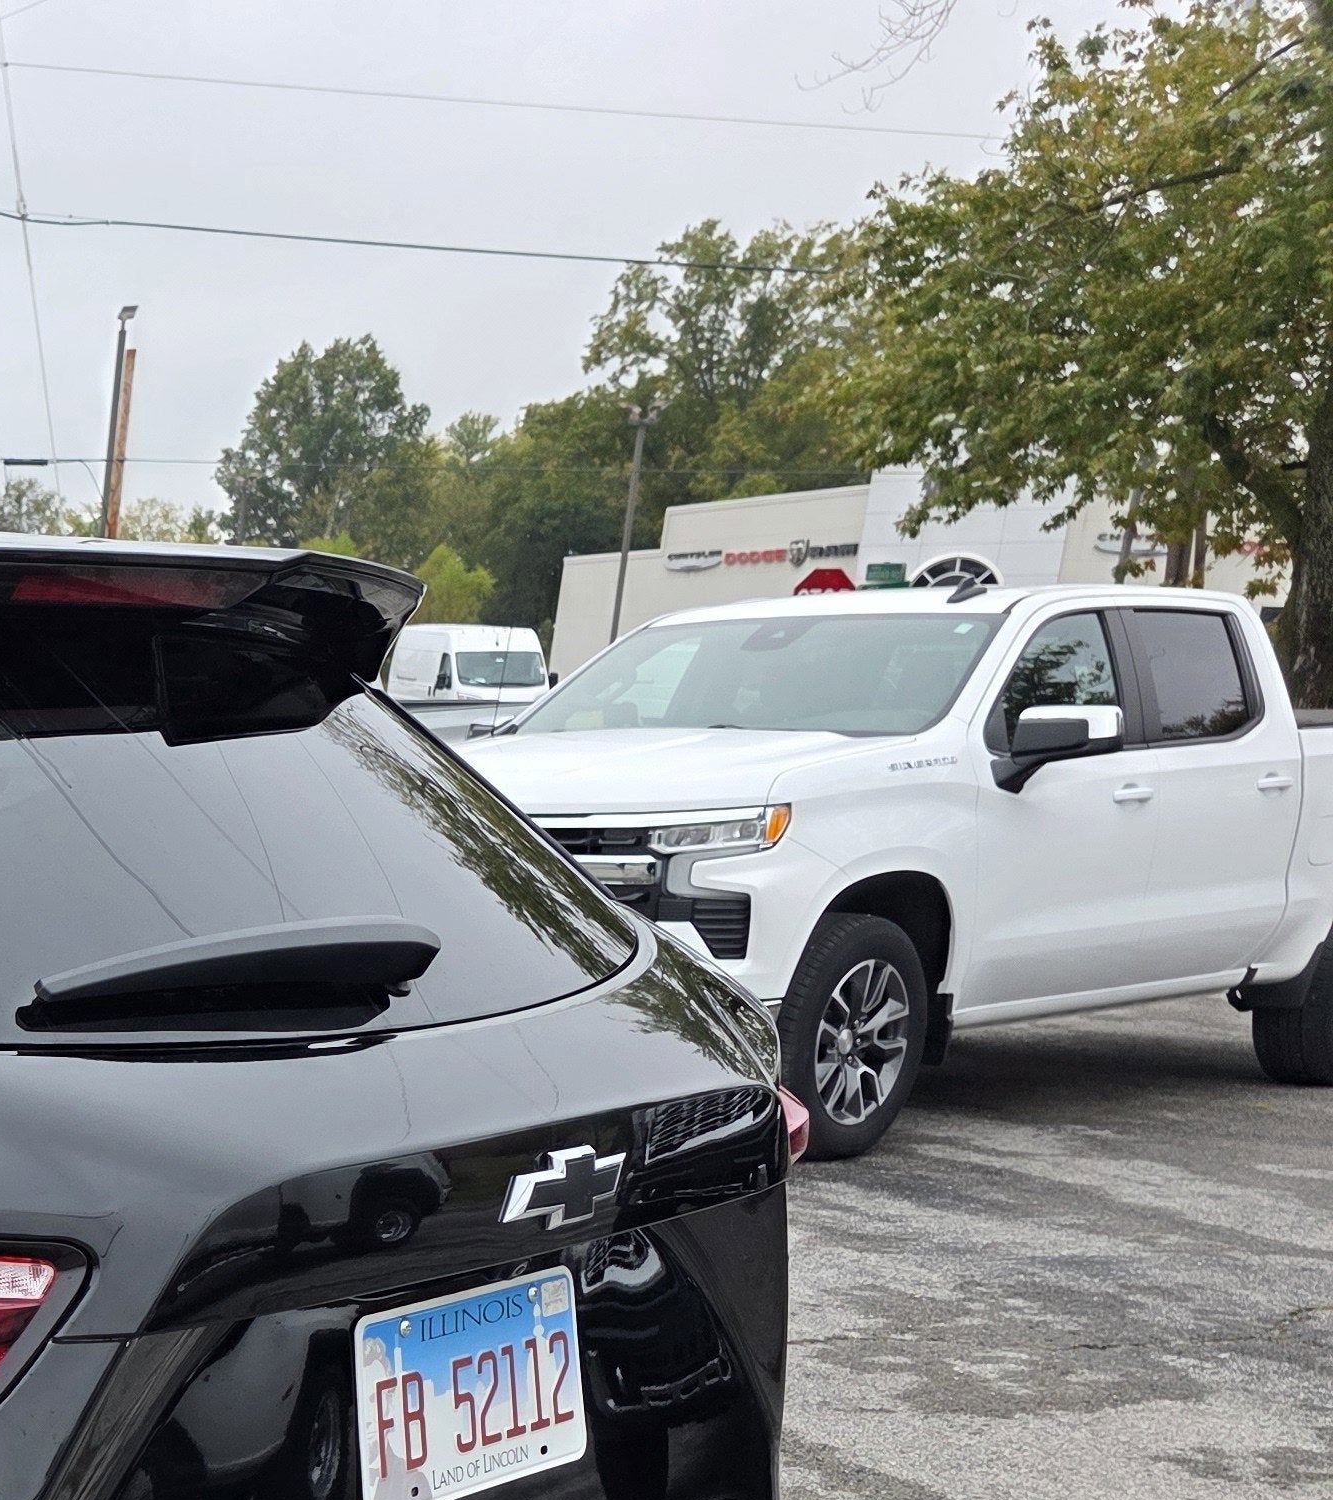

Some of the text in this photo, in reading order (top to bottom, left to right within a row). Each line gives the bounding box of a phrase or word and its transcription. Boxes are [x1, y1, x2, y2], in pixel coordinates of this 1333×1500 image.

[724, 549, 788, 566] DODGE
[807, 543, 859, 560] RAM
[420, 1293, 524, 1342] ILLINOIS
[375, 1329, 575, 1480] FB 52112
[432, 1444, 529, 1491] LAND OF LINCOLN
